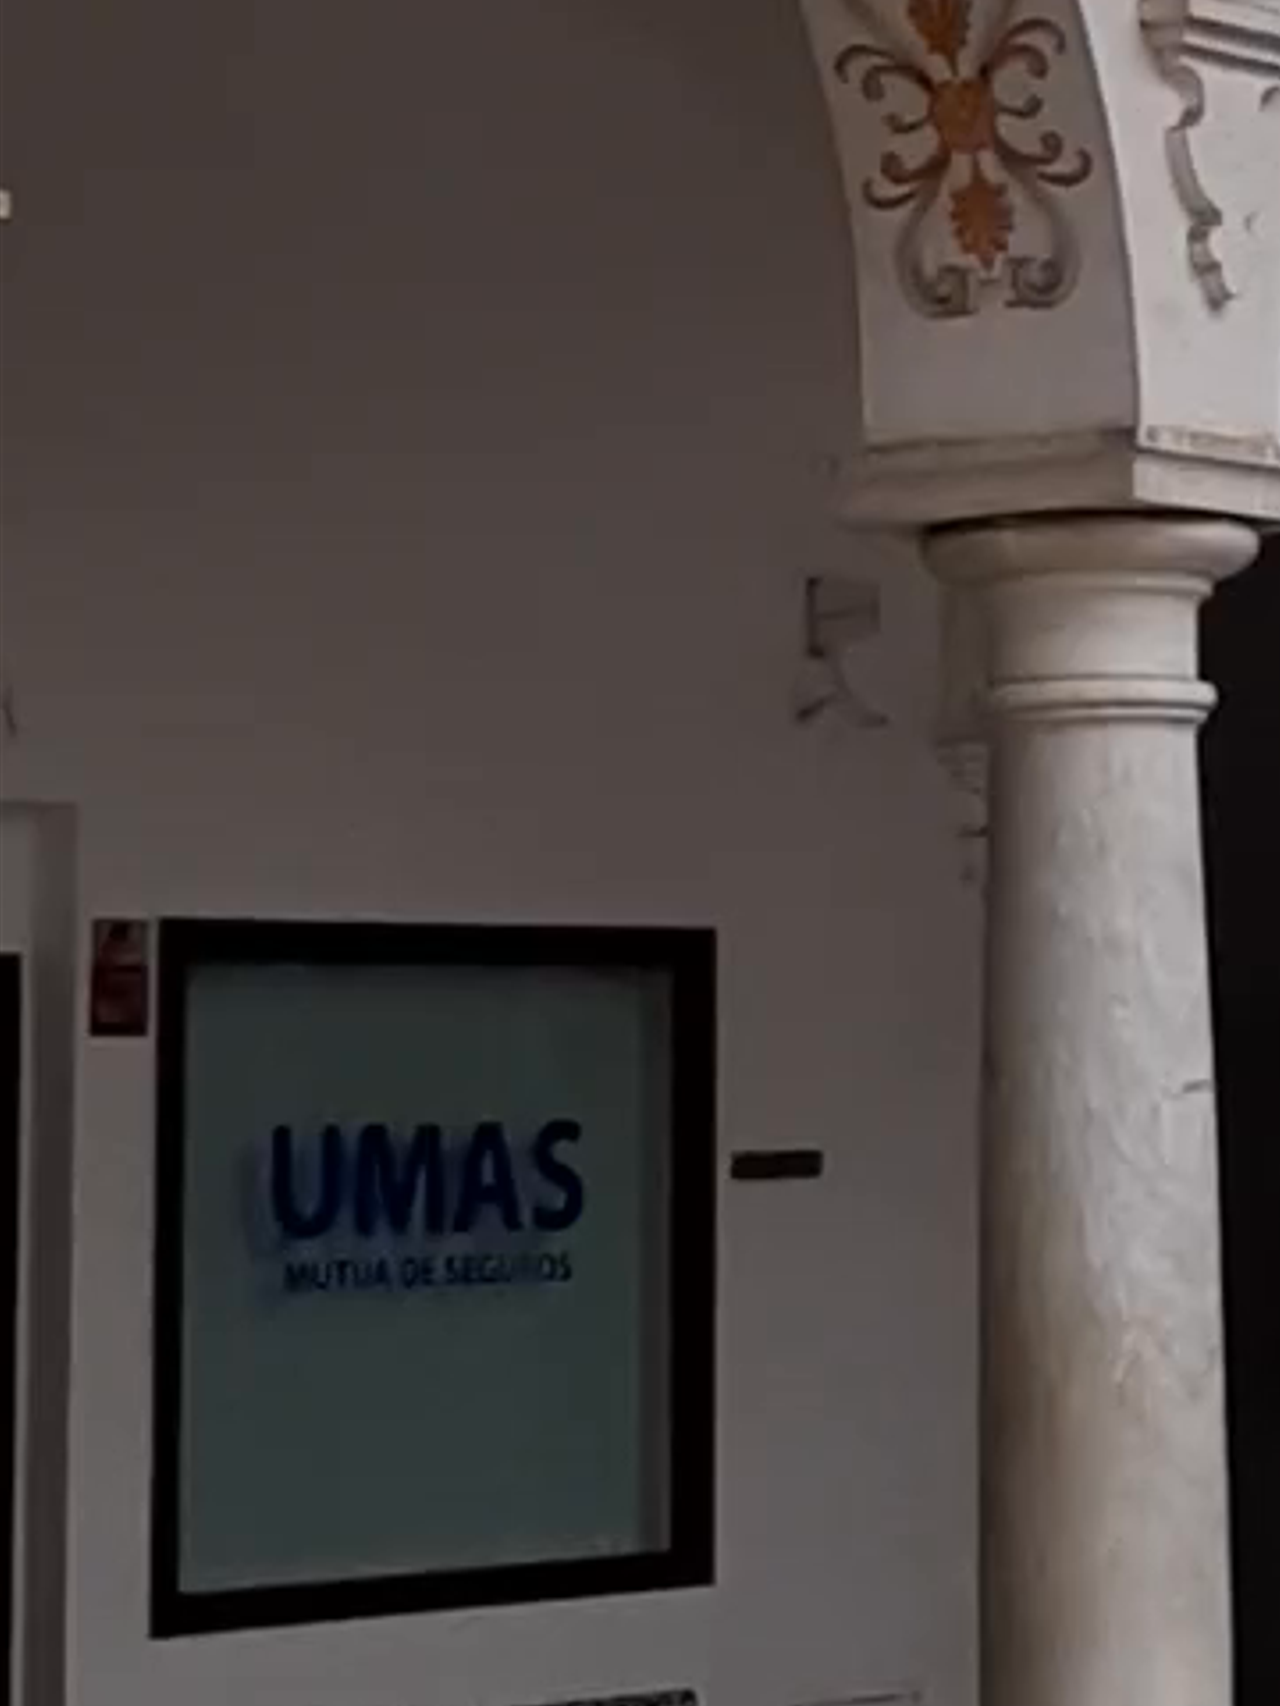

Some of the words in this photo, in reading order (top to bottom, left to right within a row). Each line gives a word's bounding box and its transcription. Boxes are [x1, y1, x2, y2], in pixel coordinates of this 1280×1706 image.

[271, 1118, 584, 1238] UMAS
[284, 1258, 388, 1292] MUTUA
[400, 1256, 434, 1289] DE
